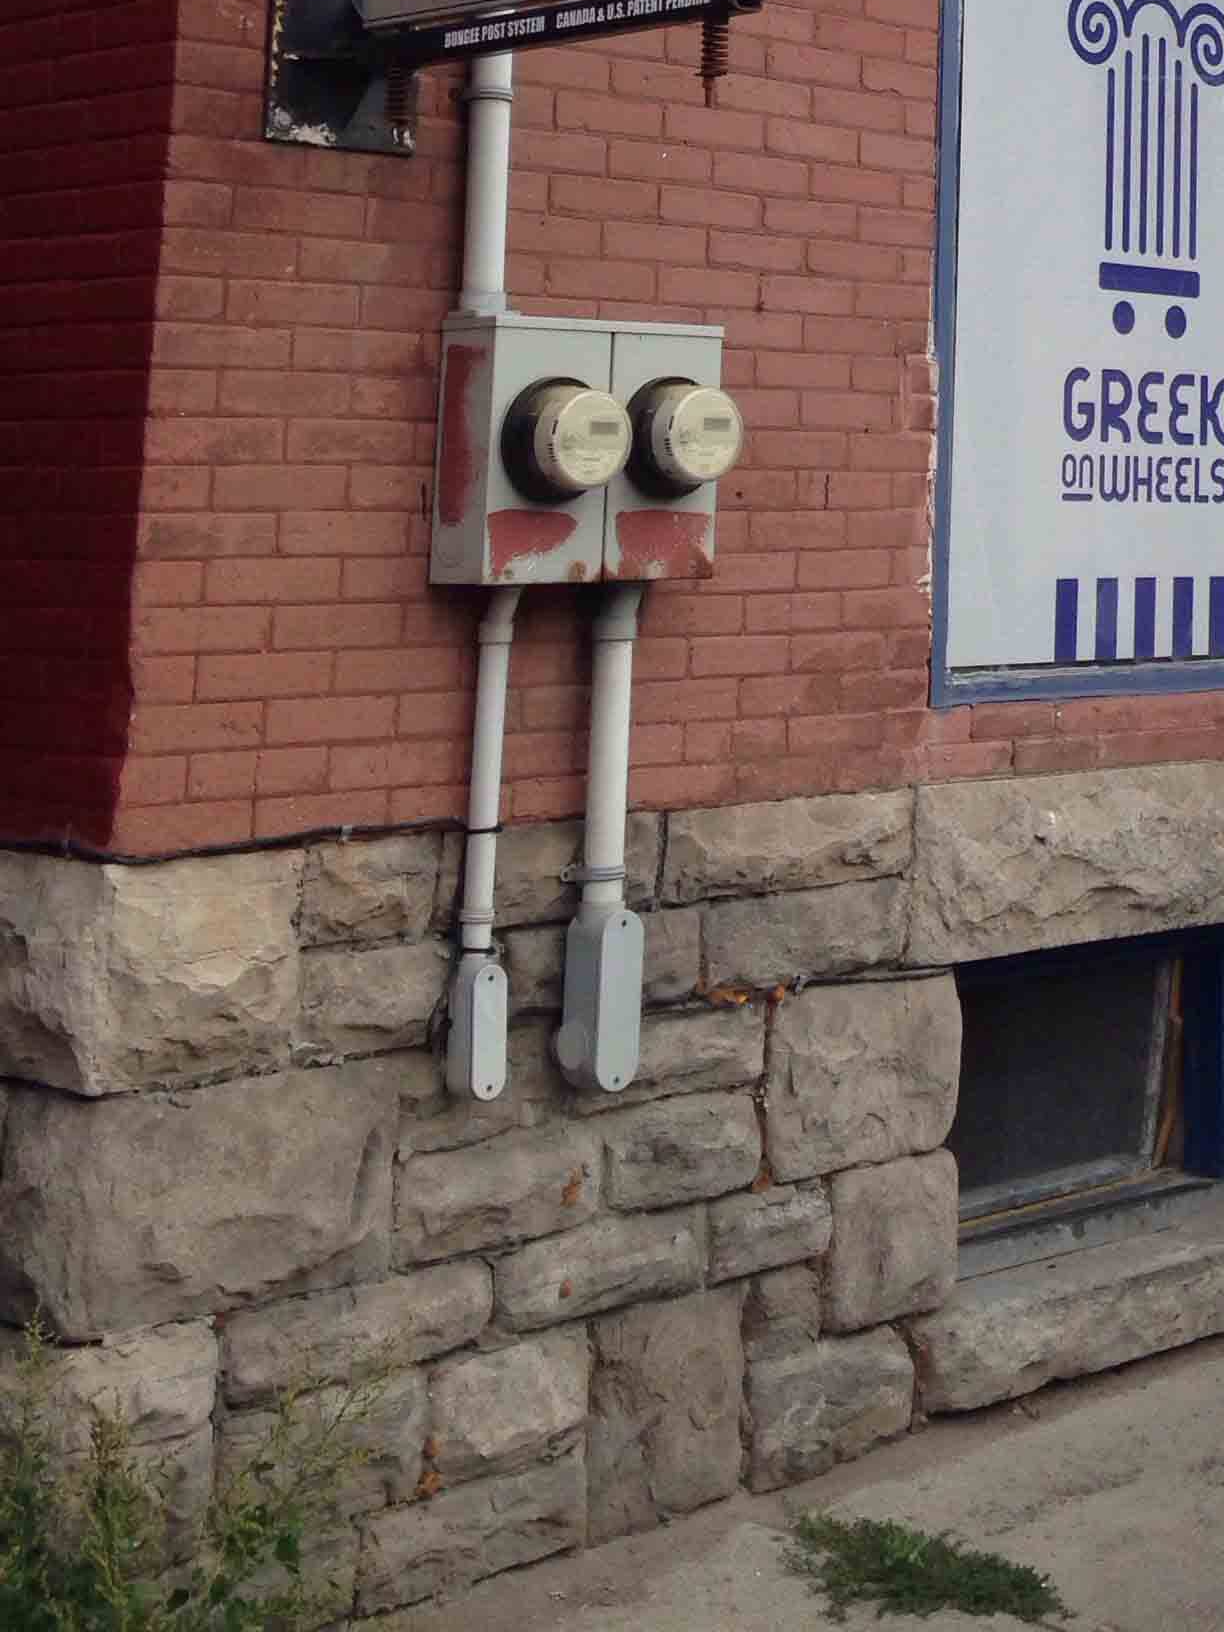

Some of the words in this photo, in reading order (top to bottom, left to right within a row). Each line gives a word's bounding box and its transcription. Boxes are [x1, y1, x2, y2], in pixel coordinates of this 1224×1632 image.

[481, 22, 506, 41] POST
[507, 16, 545, 37] SYSTEM
[556, 7, 596, 29] CANADA
[597, 9, 605, 21] &
[607, 3, 625, 20] U.S.
